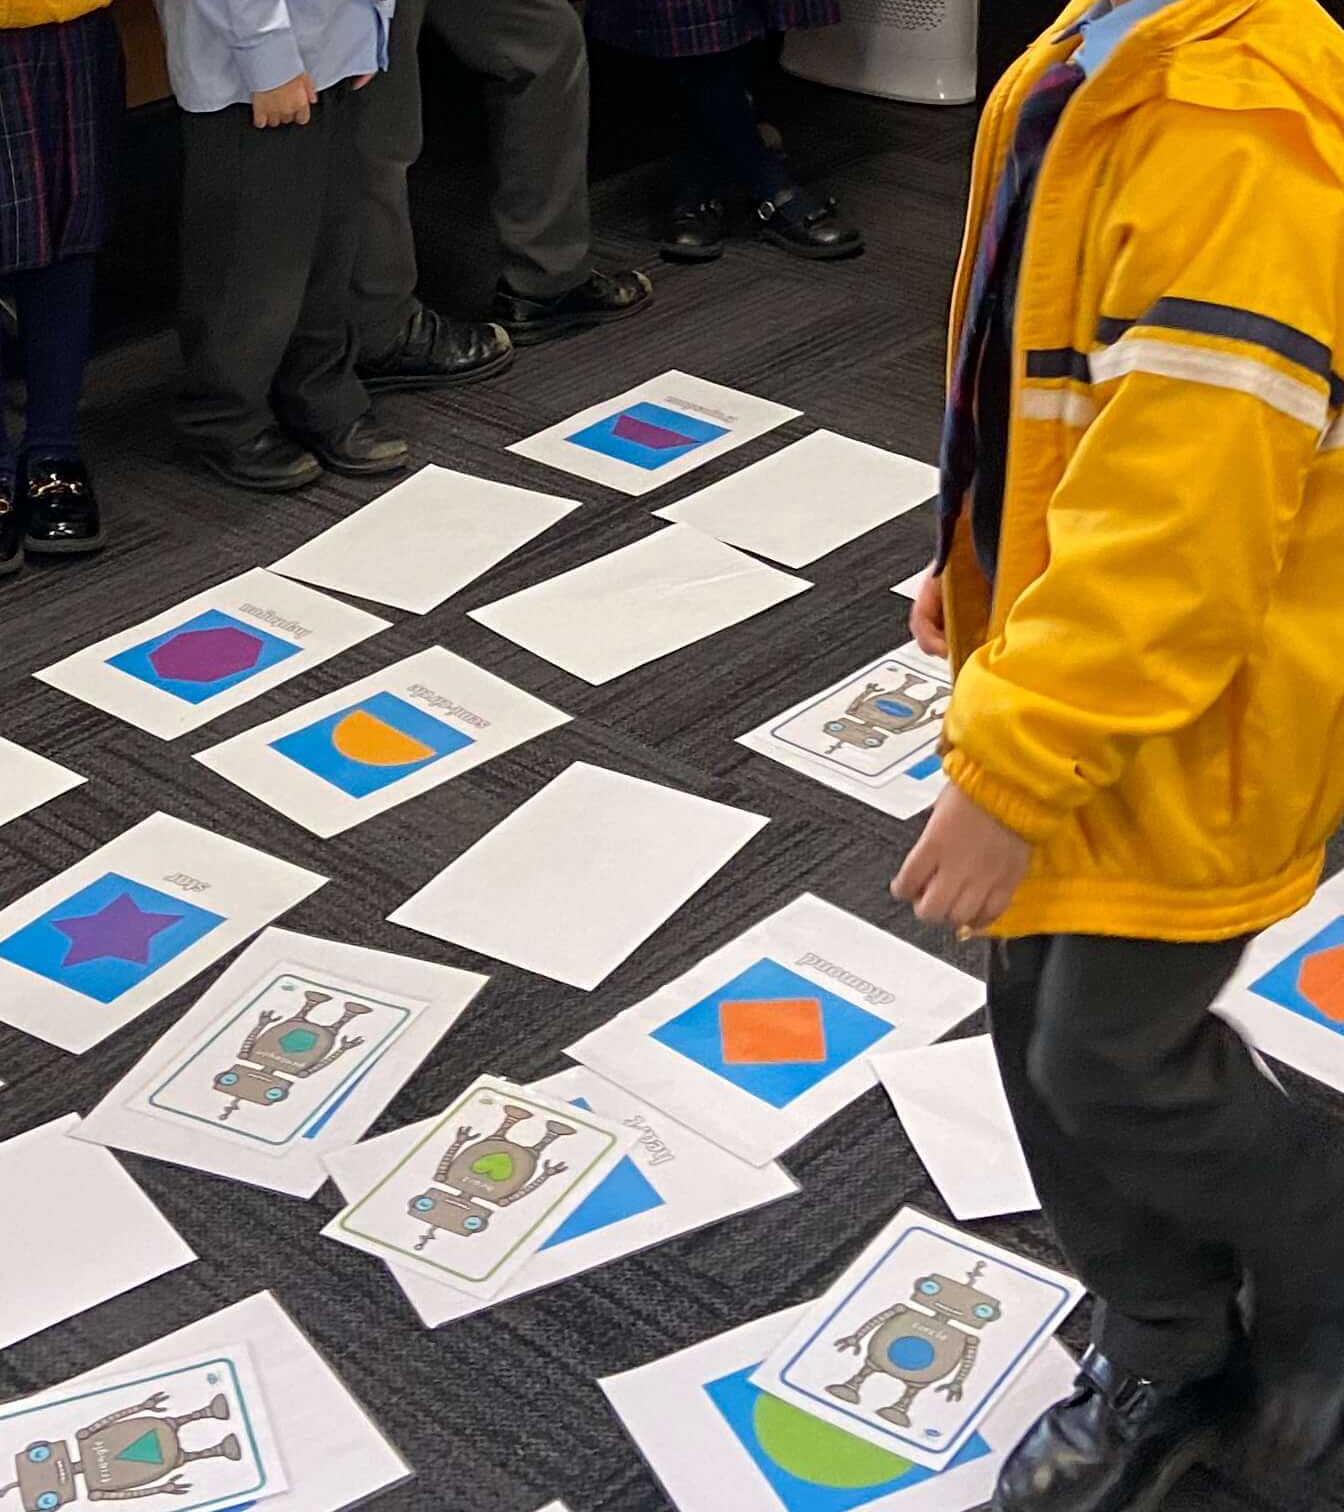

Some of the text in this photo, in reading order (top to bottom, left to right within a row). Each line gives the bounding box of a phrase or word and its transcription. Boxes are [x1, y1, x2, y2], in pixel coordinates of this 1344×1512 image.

[163, 871, 210, 894] star
[795, 951, 896, 1007] diamond
[623, 1114, 677, 1166] heart
